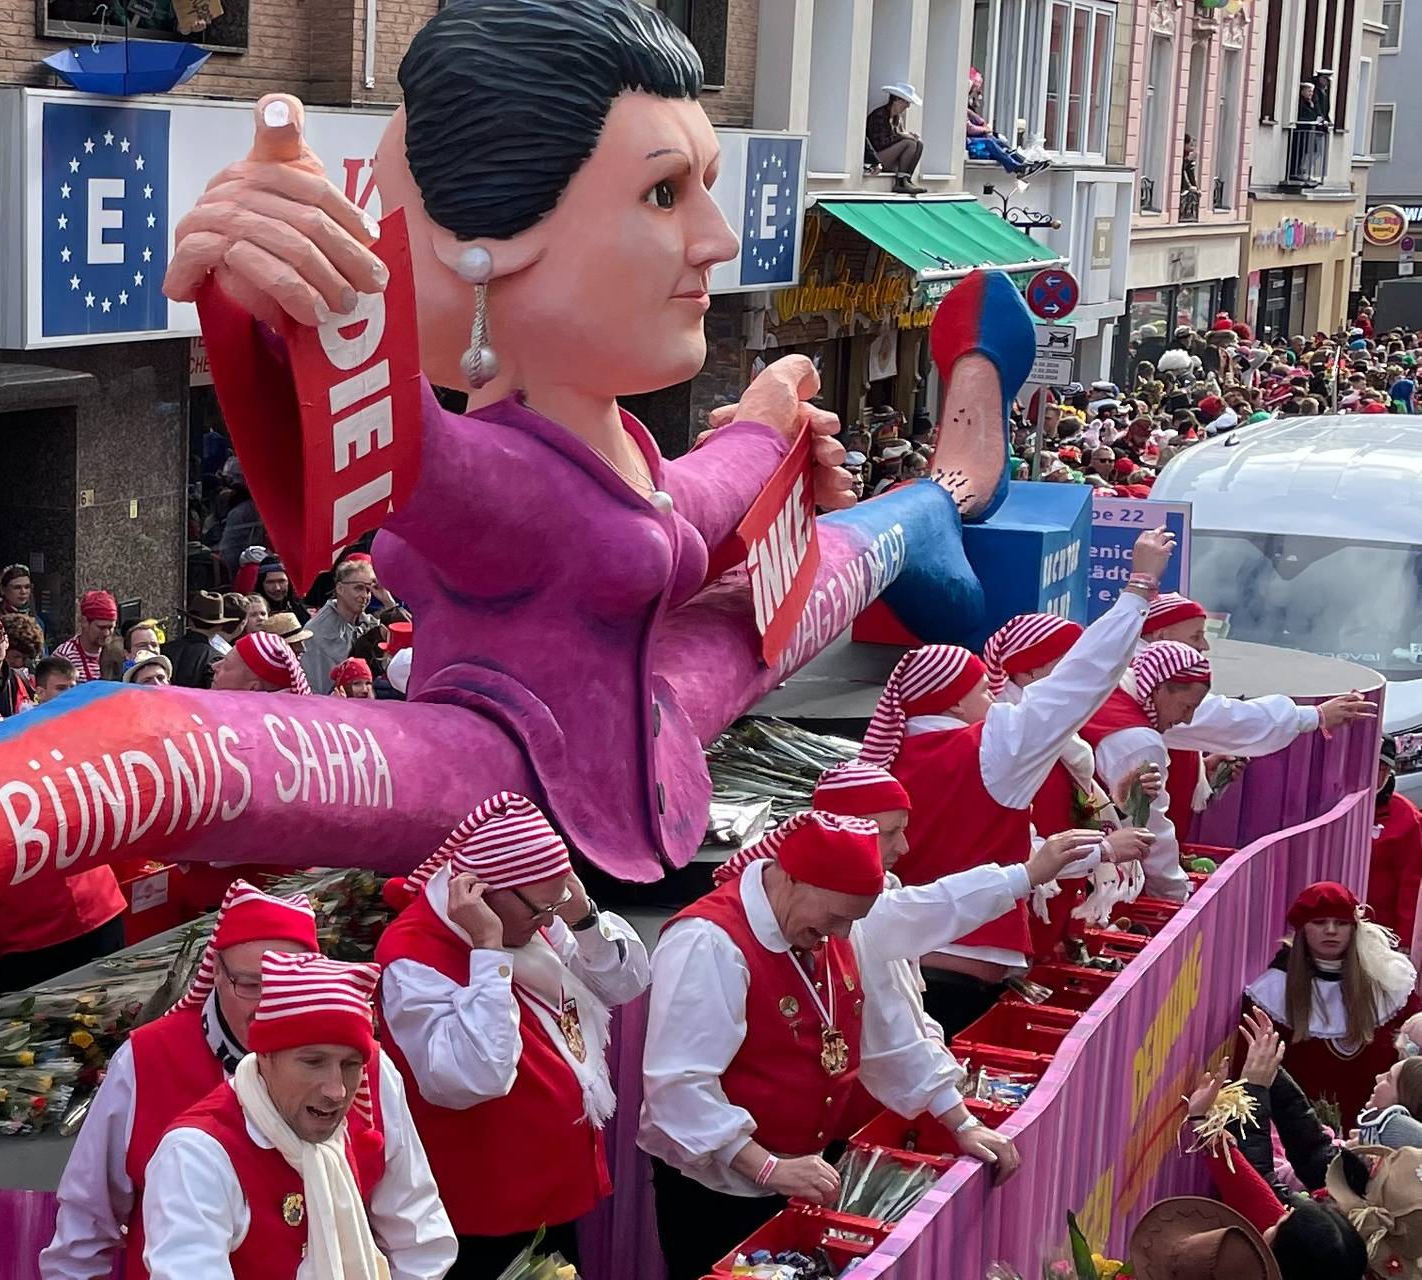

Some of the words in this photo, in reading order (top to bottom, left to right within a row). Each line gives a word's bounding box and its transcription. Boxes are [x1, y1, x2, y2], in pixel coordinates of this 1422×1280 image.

[87, 178, 125, 264] E
[760, 184, 778, 240] E
[318, 290, 393, 473] DIE
[1120, 509, 1145, 523] 22
[264, 713, 393, 810] SAHRA
